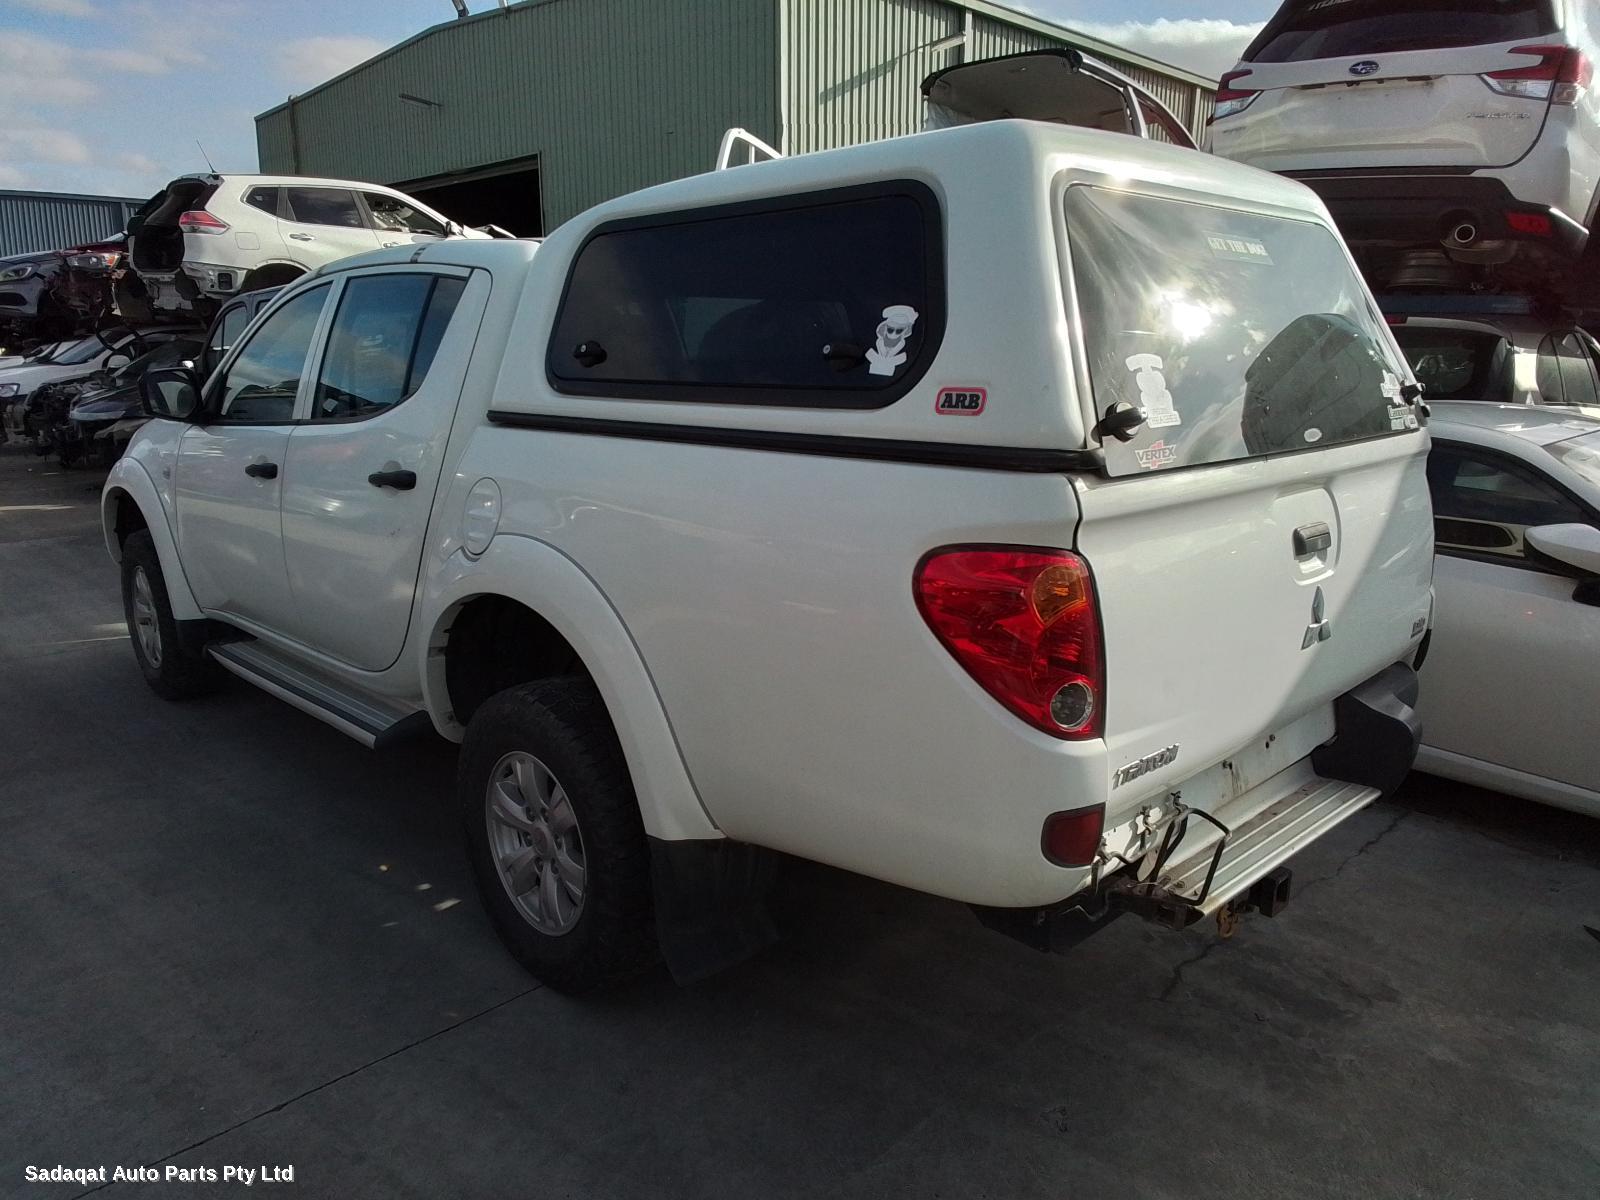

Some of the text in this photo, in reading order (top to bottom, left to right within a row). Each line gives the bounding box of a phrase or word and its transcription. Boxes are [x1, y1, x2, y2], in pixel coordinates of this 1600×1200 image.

[1226, 239, 1248, 253] THE
[940, 392, 981, 410] ARB
[1134, 445, 1177, 463] VERTEX
